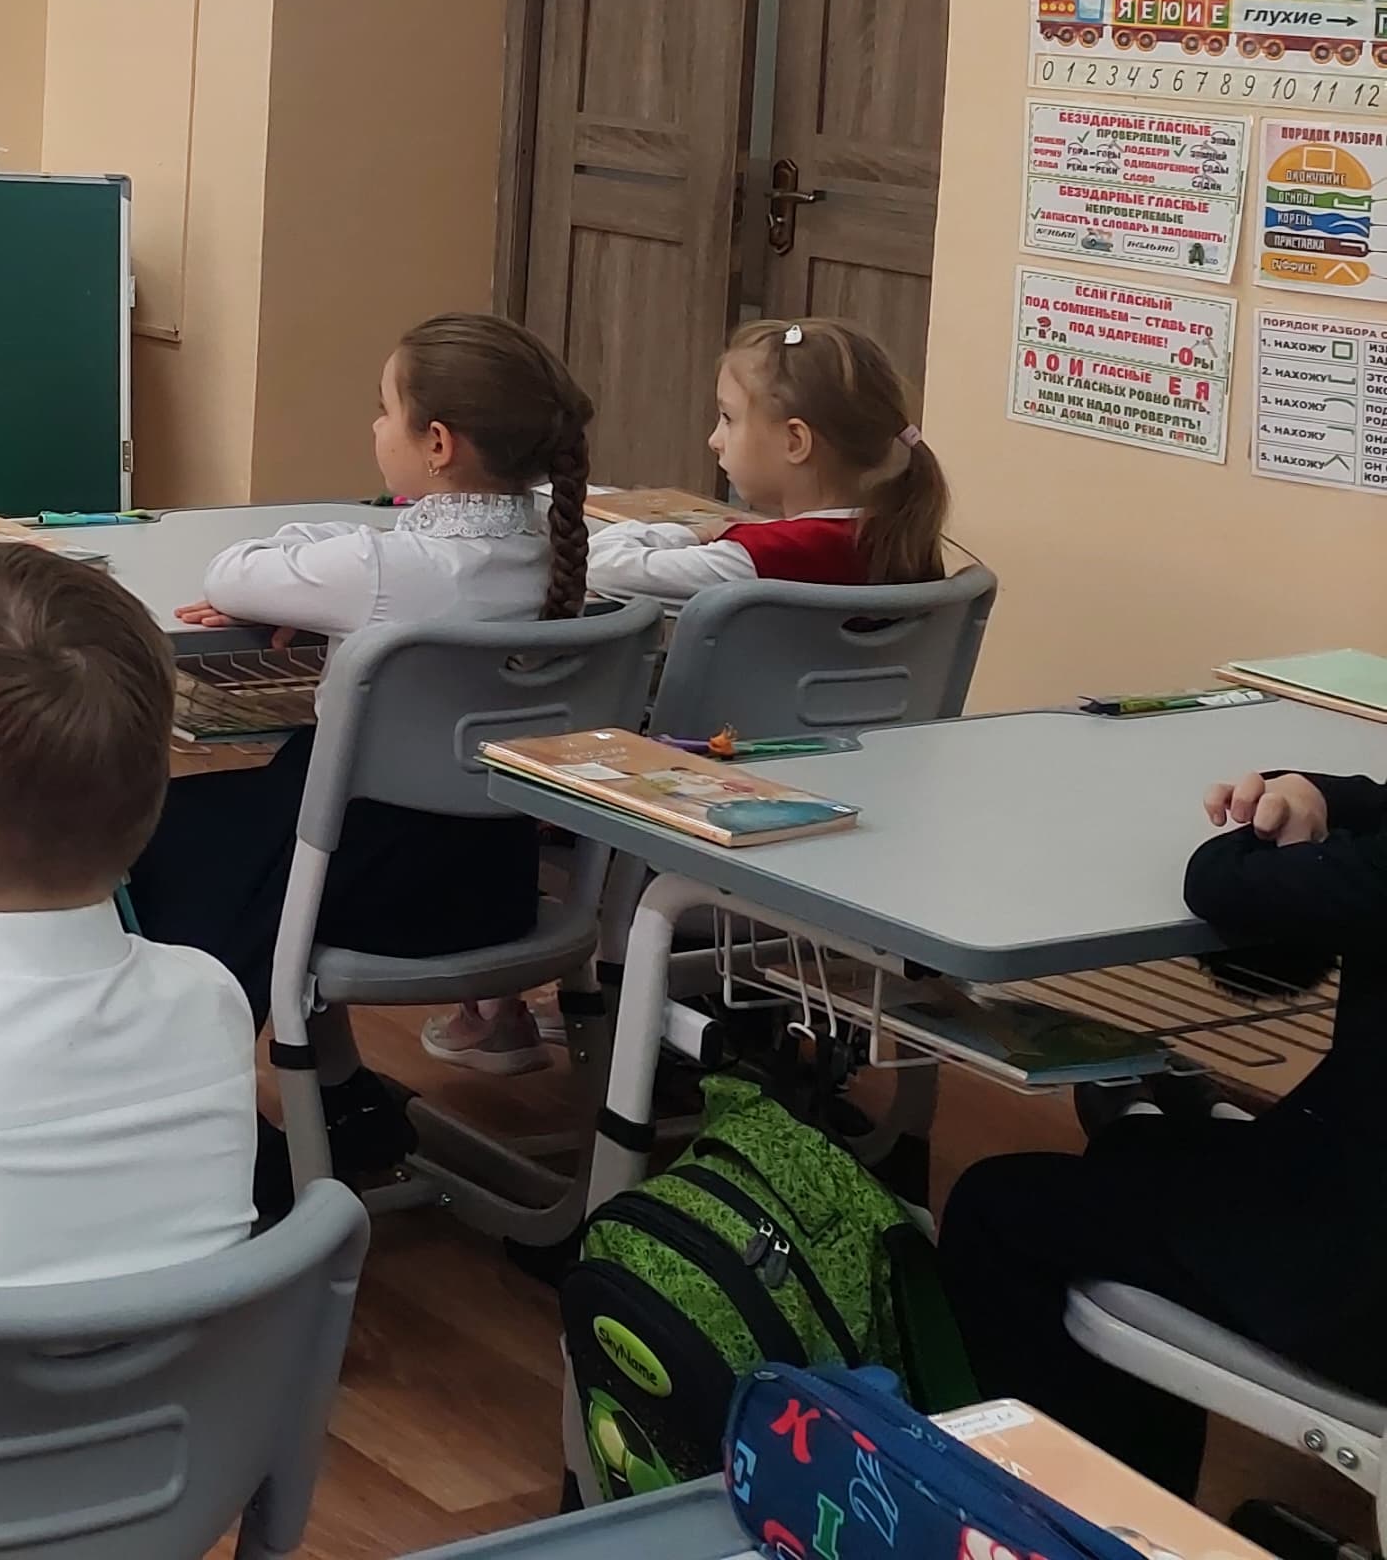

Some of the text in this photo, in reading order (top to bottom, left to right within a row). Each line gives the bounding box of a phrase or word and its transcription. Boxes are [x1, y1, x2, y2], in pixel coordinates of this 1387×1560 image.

[1244, 8, 1322, 26] глухие
[1059, 112, 1211, 136] БЕЗУДАРНЫЕ ГЛАСНЫЕ
[1096, 128, 1182, 146] ПРОВЕРЯЕМЫЕ
[1059, 185, 1209, 213] БЕЗУДАРНЫЕ ГЛАСНЫЕ
[1279, 191, 1314, 205] ОСНОВА
[1086, 203, 1184, 225] НЕПРОВЕРЯЕМЫЕ
[1278, 213, 1312, 225] КОРЕНЬ
[1075, 285, 1173, 311] ЕСЛИ ГЛАСНЫЙ
[1025, 296, 1213, 338] ПОД СОМНЕНЬЕМ СТАВЬ ЕГО
[1069, 321, 1168, 348] ПОД УДАРЕНИЕ!
[1263, 318, 1377, 339] ПОРЯДОК РАЗБОРА
[1274, 340, 1326, 353] НАХОЖУ
[1093, 363, 1152, 384] ГЛАСНЫЕ
[1275, 369, 1326, 382] НАХОЖУ
[1033, 370, 1064, 385] ЭТИХ
[1067, 377, 1126, 398] ГЛАСНЫХ
[1129, 388, 1170, 406] РОВНО
[1038, 389, 1201, 431] НАМ ИХ НАДО ПРОВЕРЯТЬ!
[1275, 397, 1326, 412] НАХОЖУ
[1274, 426, 1326, 441] НАХОЖУ
[1274, 455, 1326, 469] НАХОЖУ
[598, 1327, 658, 1386] SkyName
